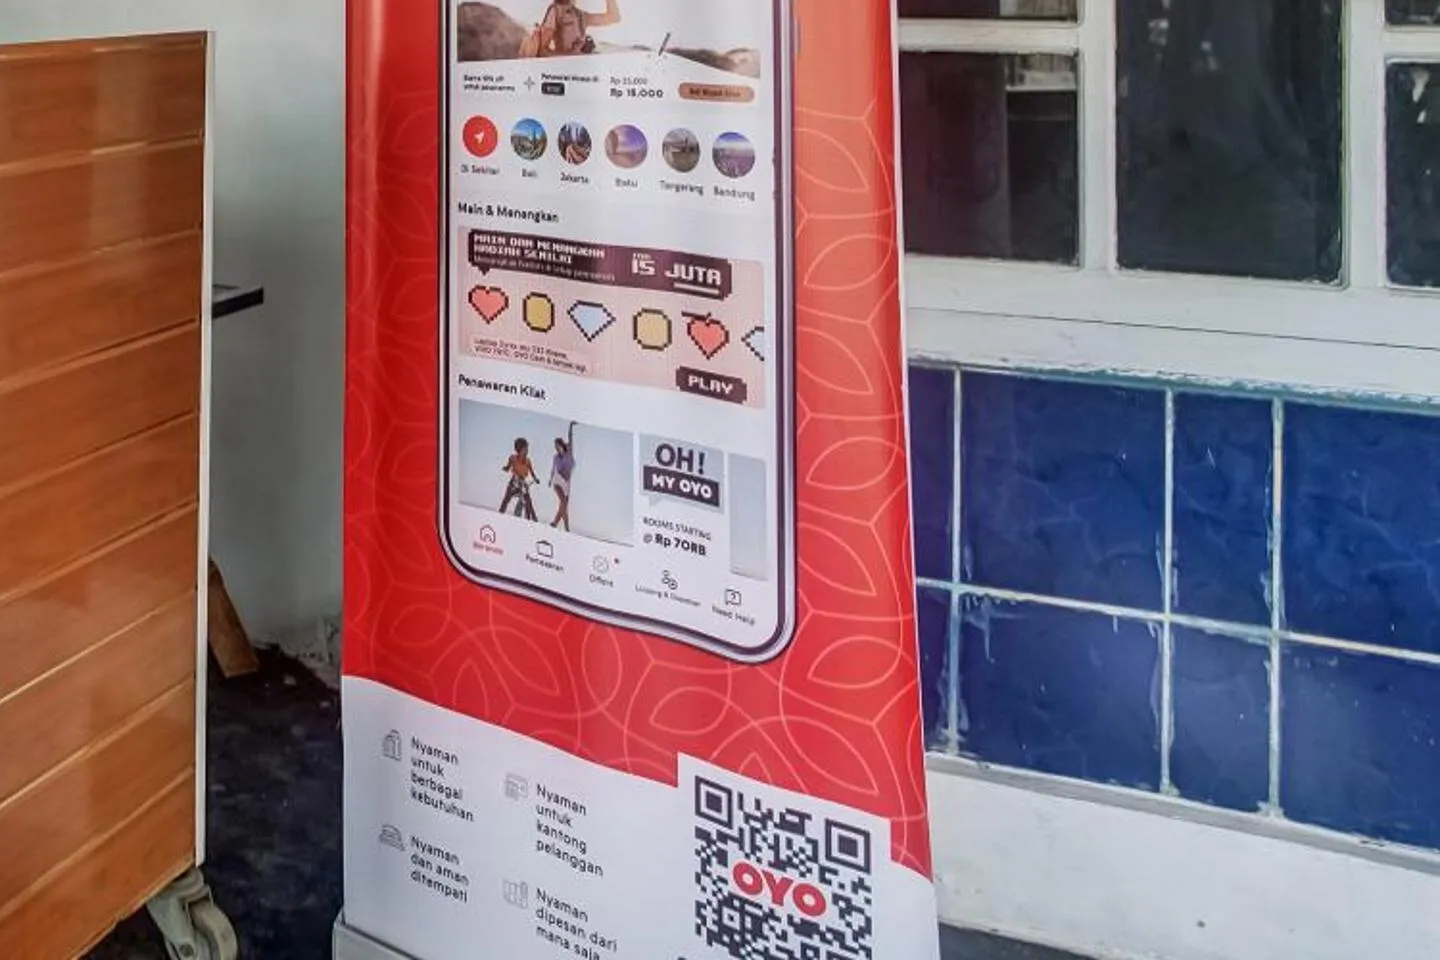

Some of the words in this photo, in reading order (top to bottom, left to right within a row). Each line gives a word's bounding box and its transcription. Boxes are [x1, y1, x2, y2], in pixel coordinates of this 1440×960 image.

[458, 201, 484, 215] Main
[485, 205, 494, 216] &
[496, 206, 559, 223] Menangkan
[664, 263, 722, 286] JUTA
[459, 373, 517, 395] Penawaran
[520, 384, 546, 400] Kilat
[688, 374, 734, 395] PLAY
[652, 474, 675, 489] MY
[679, 479, 712, 498] OYO
[655, 533, 671, 548] Rp
[411, 736, 459, 765] Nyaman
[411, 757, 444, 777] untuk
[411, 772, 463, 800] berbagai
[536, 783, 587, 816] Nyaman
[410, 789, 474, 822] kebutuhan
[536, 804, 573, 828] untuk
[410, 835, 459, 865] Nyaman
[536, 820, 587, 854] kantong
[410, 853, 433, 873] dan
[436, 865, 469, 886] aman
[536, 839, 603, 876] pelanggan
[410, 870, 467, 902] ditempati
[732, 861, 827, 918] OYO
[536, 888, 588, 922] Nyaman
[536, 907, 586, 939] dipesan
[589, 931, 617, 953] dari
[536, 925, 570, 950] mana
